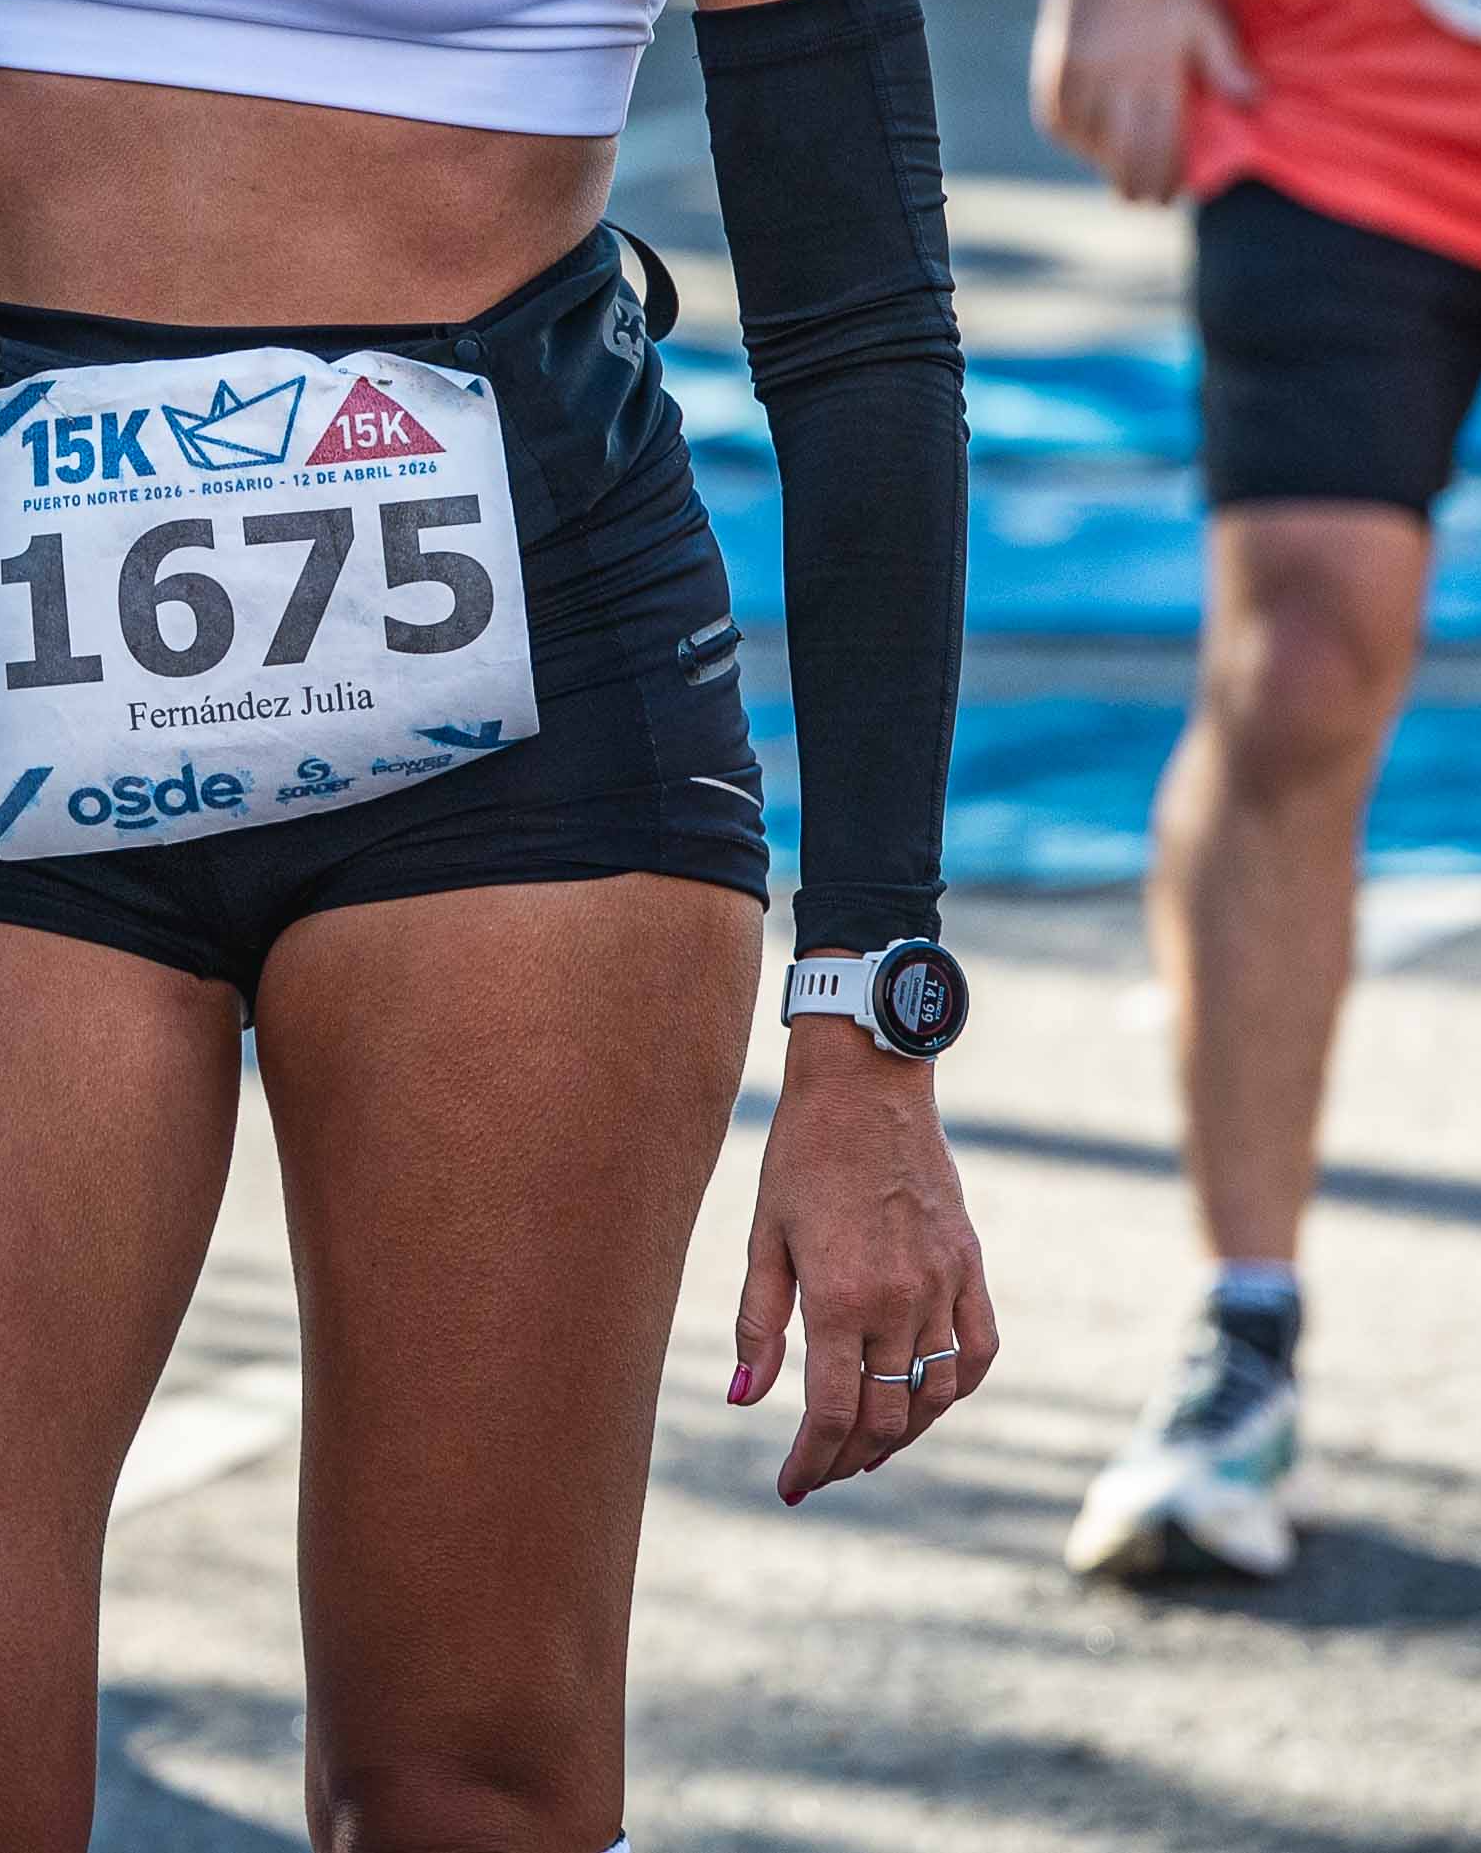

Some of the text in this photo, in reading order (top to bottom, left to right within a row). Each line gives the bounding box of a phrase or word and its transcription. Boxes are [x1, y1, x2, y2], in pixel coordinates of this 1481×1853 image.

[22, 409, 156, 487] 15K
[337, 411, 410, 449] 15K
[23, 494, 81, 512] PUERTO
[87, 488, 138, 505] NORTE
[144, 485, 183, 500] 2026
[202, 476, 273, 495] ROSARIO
[293, 474, 310, 487] 12
[317, 471, 337, 485] DE
[343, 465, 392, 482] ABRIL
[399, 460, 437, 476] 2026
[0, 494, 495, 690] 1675
[127, 682, 375, 731] Fernández Julia
[67, 762, 245, 829] osde
[921, 980, 938, 1022] 14.99
